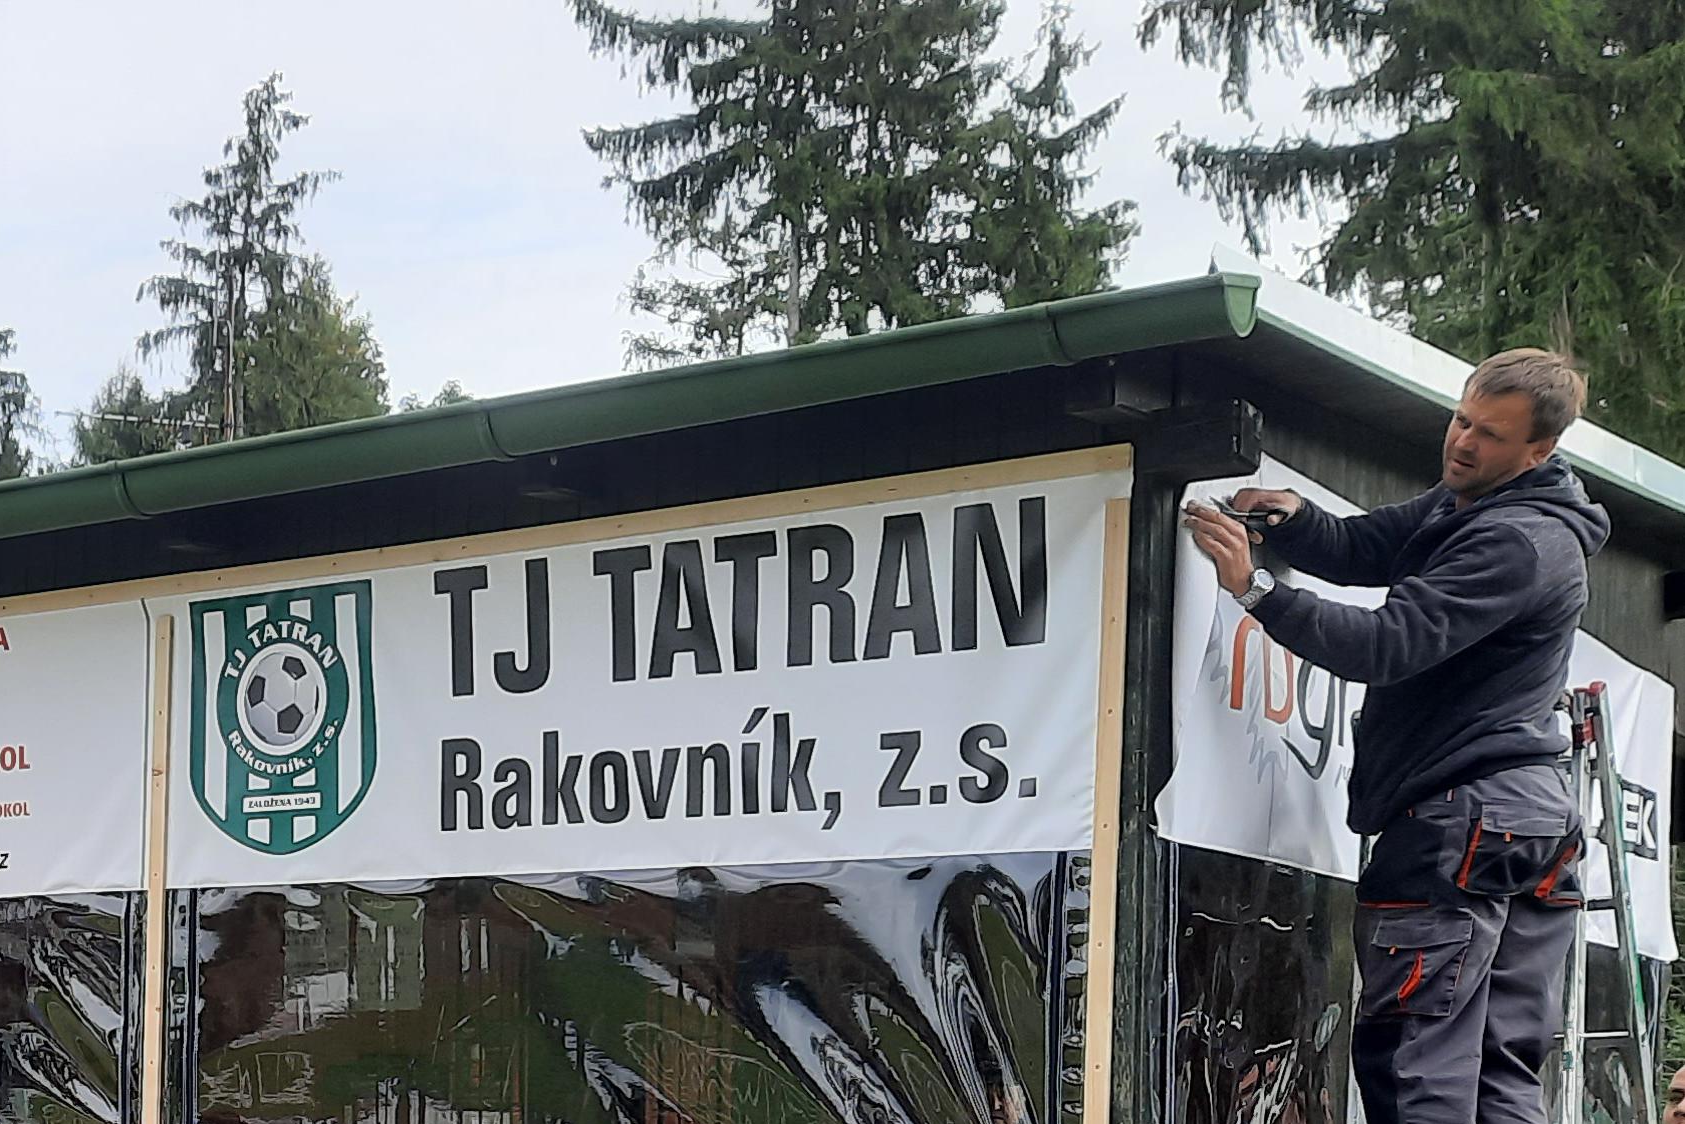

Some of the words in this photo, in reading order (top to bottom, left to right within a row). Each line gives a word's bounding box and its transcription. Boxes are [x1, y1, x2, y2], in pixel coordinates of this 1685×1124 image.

[224, 648, 247, 680] TJ
[247, 620, 339, 670] TATRAN
[433, 557, 551, 697] TJ
[592, 495, 1047, 684] TATRAN
[440, 707, 842, 832] Rakovník,
[877, 722, 1039, 809] z.s.
